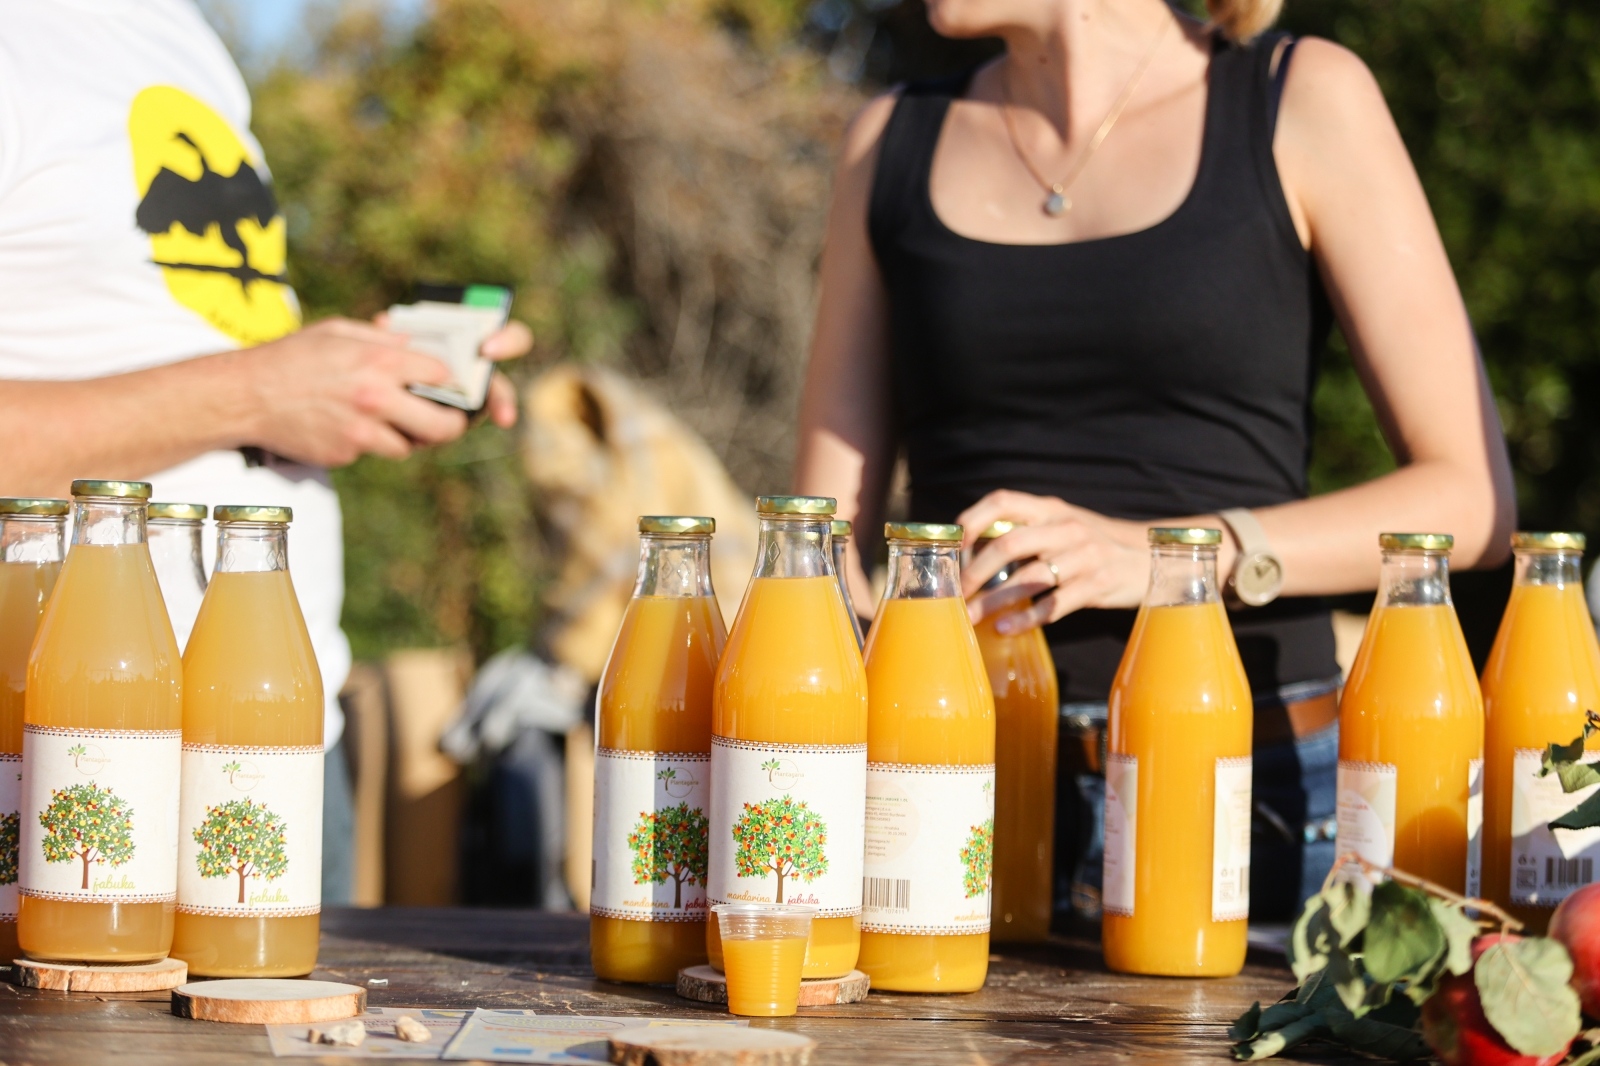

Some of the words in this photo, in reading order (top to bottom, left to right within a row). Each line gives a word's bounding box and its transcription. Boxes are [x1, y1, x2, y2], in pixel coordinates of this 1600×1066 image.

[774, 770, 805, 779] Plantagana
[670, 779, 699, 787] Plantagana
[92, 873, 136, 894] jabuka
[248, 887, 290, 908] jabuka
[622, 896, 670, 909] mandarina
[726, 890, 772, 903] mandarina
[787, 893, 820, 906] jabuka
